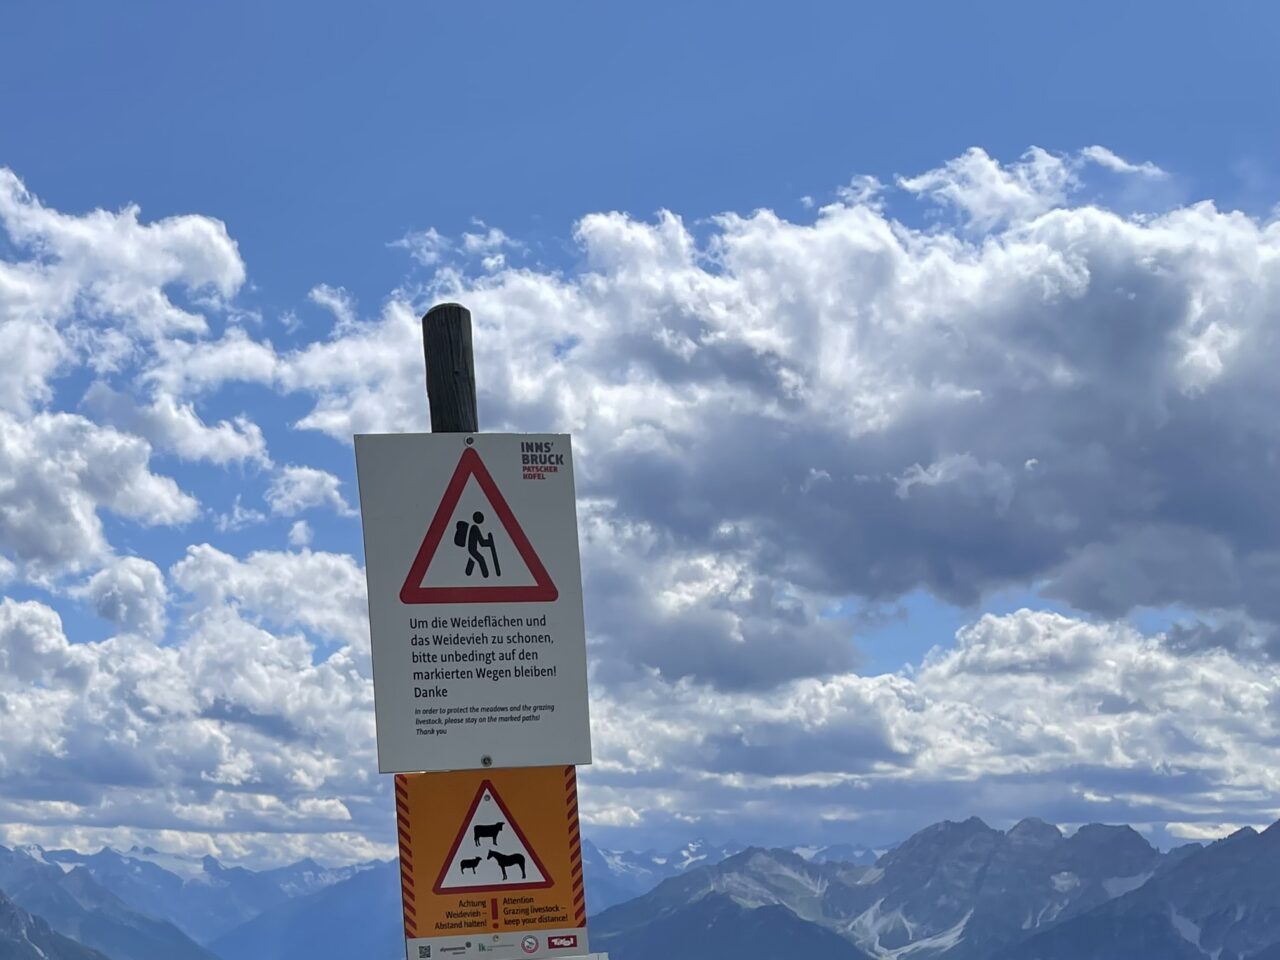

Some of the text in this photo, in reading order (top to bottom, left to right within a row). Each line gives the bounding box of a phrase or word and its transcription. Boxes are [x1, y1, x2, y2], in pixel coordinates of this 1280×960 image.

[521, 442, 554, 453] INNS'
[522, 454, 564, 465] BRUCK
[410, 614, 546, 629] Um die Weideflächen und
[411, 632, 554, 646] das Weidevieh zu schonen,
[412, 649, 538, 664] bitte unbedingt auf den
[413, 666, 556, 681] markierten Wegen bleiben!
[414, 686, 448, 698] Danke
[436, 729, 448, 737] you
[458, 900, 487, 908] Achtung
[502, 897, 534, 905] Attention
[446, 910, 480, 919] Weidevieh
[503, 906, 530, 916] Grazing
[530, 904, 560, 914] livestock
[434, 919, 487, 930] Abstand halten!
[504, 914, 568, 926] keep your distance!
